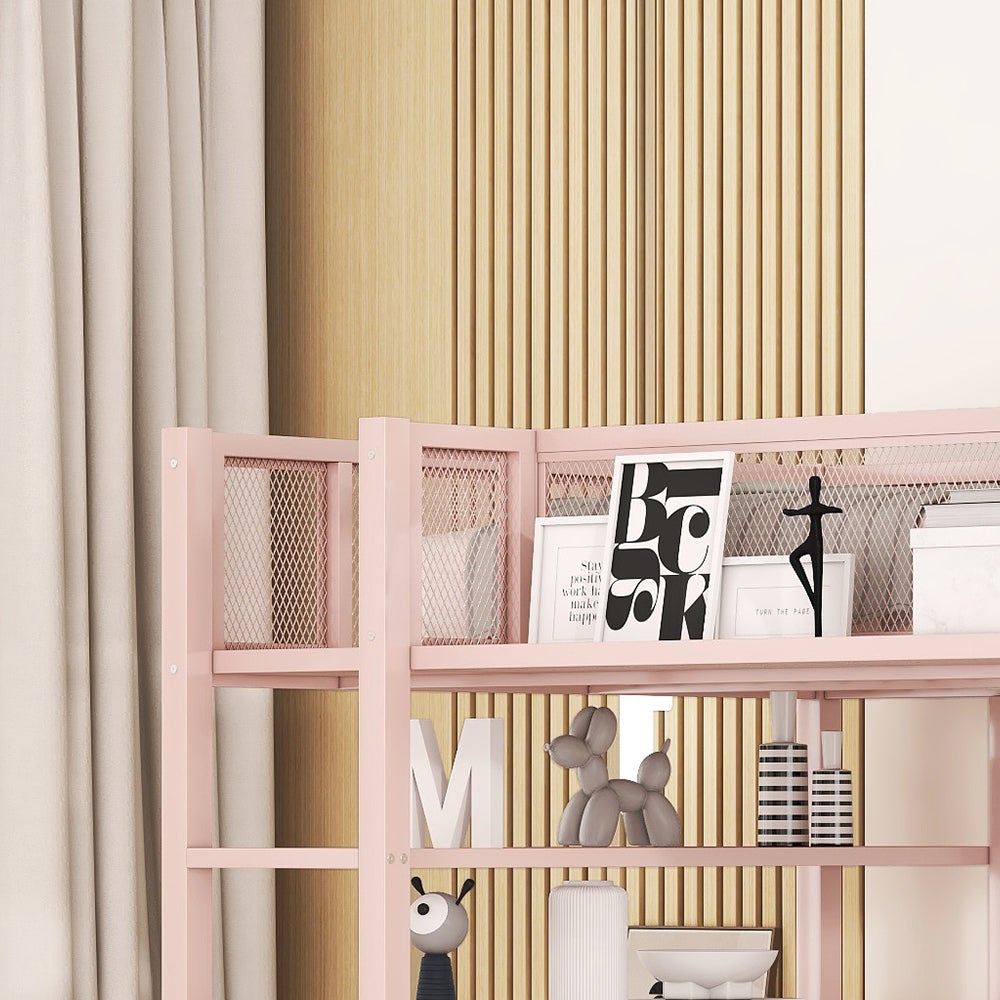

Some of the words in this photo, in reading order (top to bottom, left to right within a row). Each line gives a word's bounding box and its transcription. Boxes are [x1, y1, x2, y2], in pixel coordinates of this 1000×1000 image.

[562, 586, 587, 597] work
[571, 598, 599, 609] make
[755, 608, 772, 616] TURN
[777, 608, 789, 616] THE
